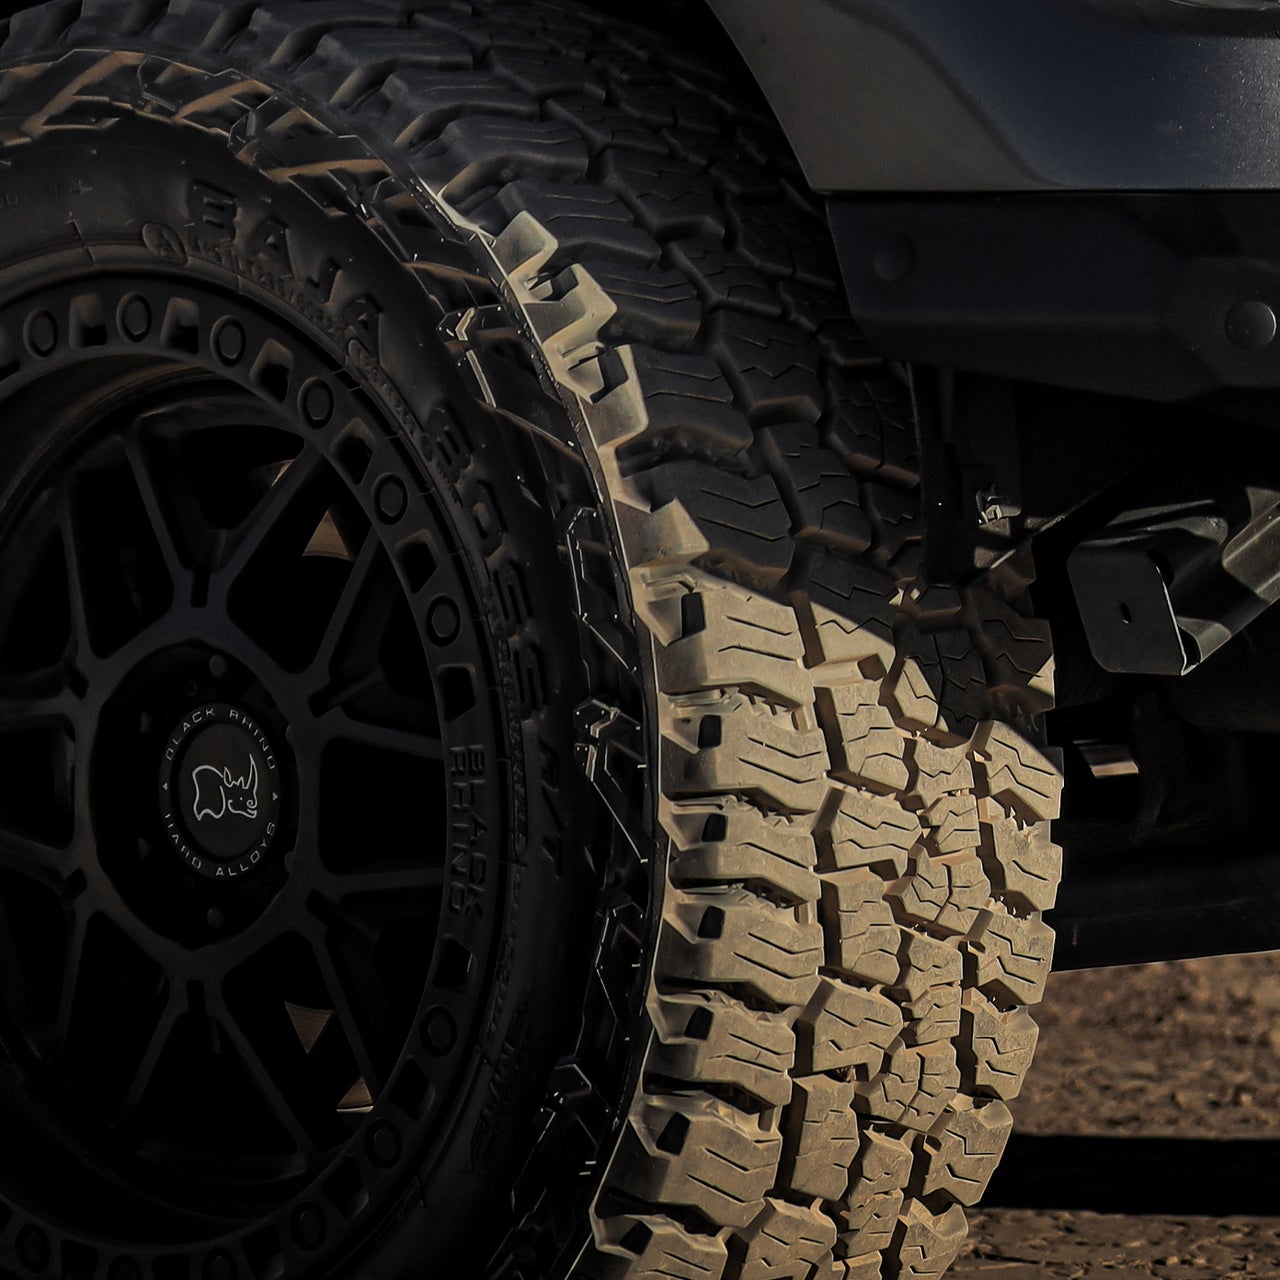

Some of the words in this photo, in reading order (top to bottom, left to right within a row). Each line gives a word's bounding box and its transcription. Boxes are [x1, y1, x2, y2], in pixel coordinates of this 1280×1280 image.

[186, 179, 383, 366] BAJA
[420, 400, 549, 716] BOSS
[165, 707, 216, 761] BLACK
[229, 709, 277, 770] RHINO
[215, 822, 275, 876] ALLOYS
[449, 745, 470, 914] RHINO
[464, 744, 488, 918] BLACK
